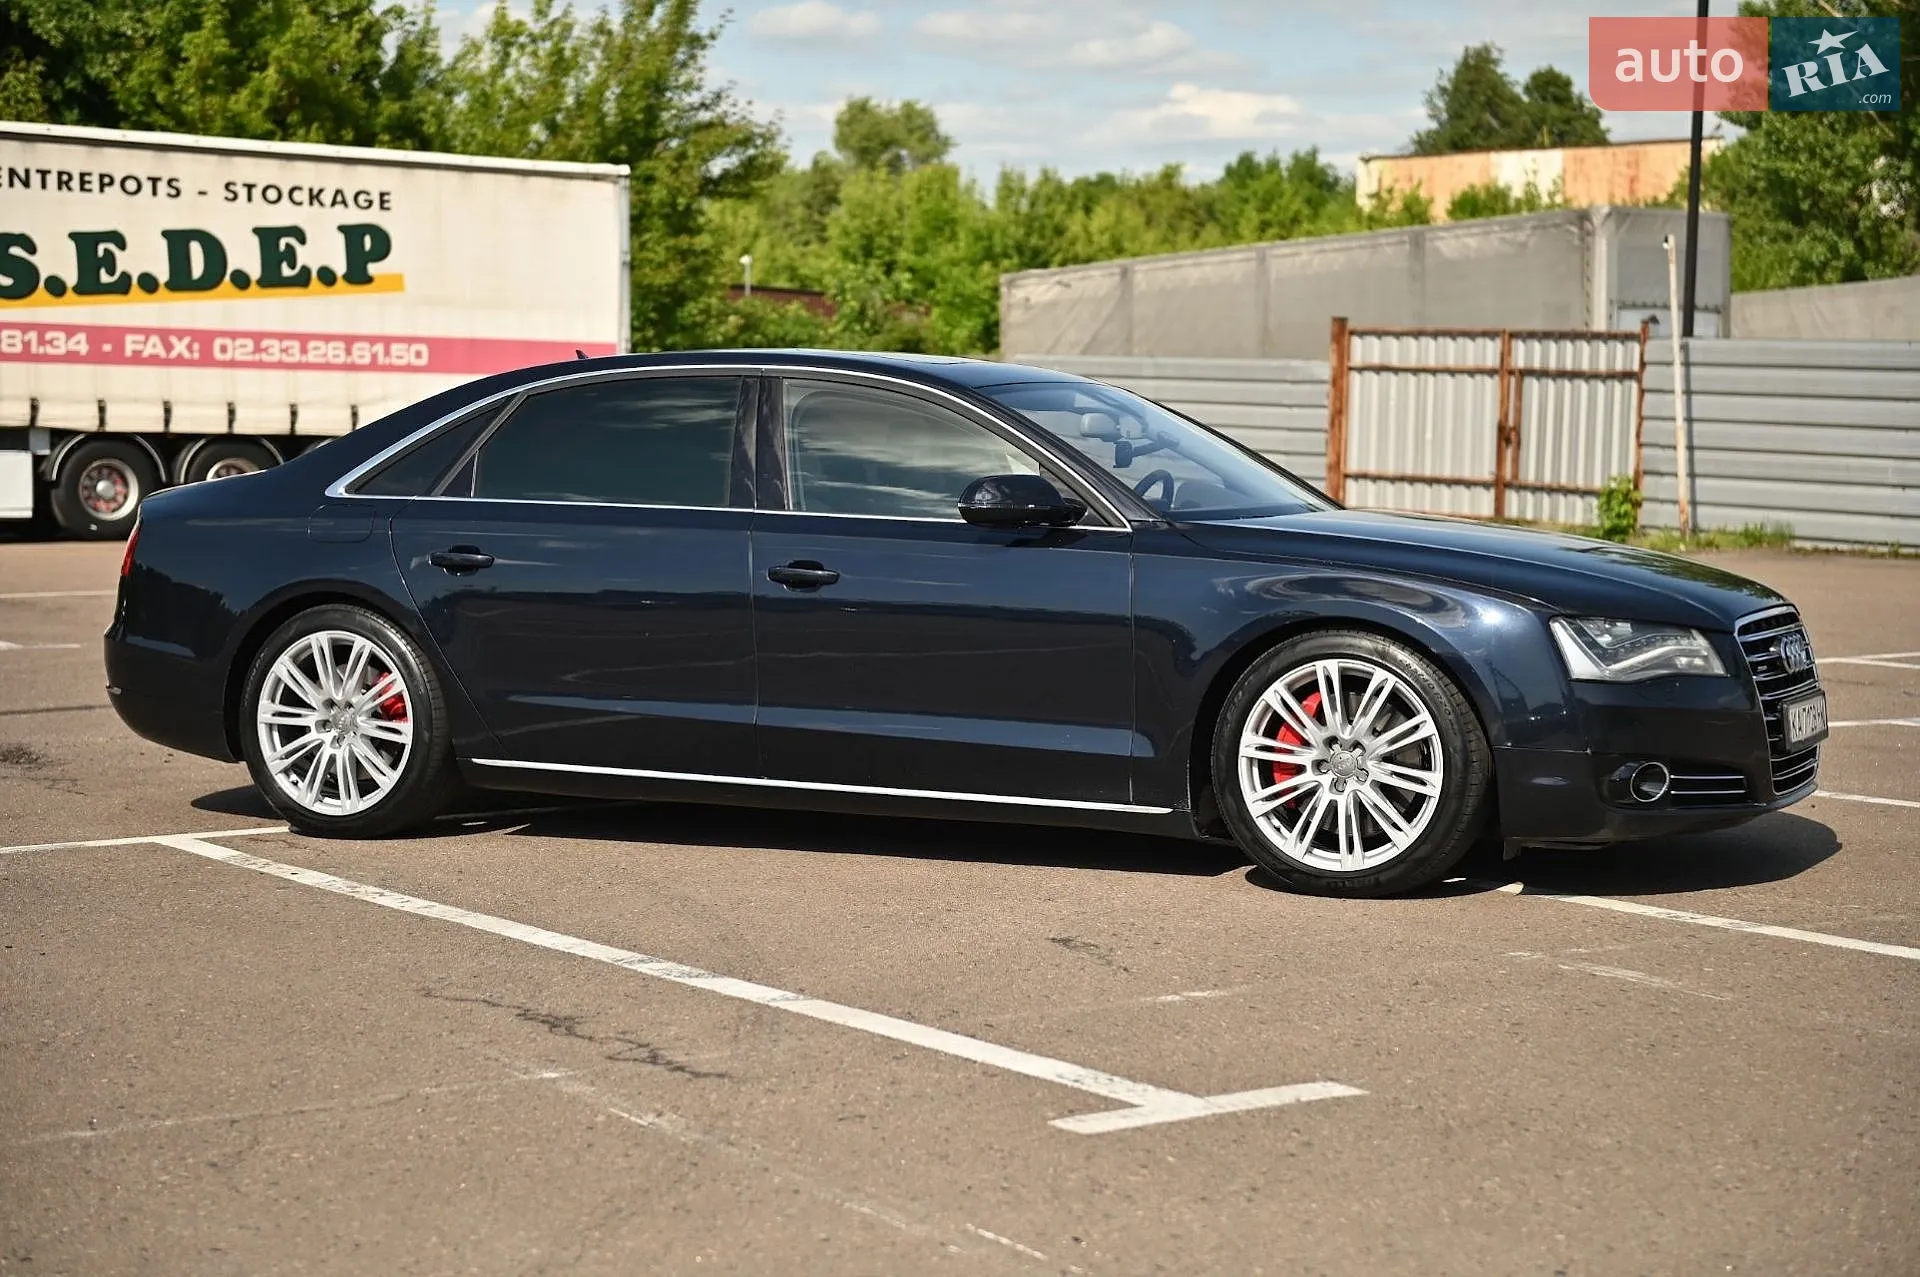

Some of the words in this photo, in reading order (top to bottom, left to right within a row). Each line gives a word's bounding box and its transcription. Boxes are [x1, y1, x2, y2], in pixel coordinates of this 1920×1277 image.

[0, 166, 182, 199] NTREPOTS
[223, 181, 392, 211] STOCKAGE
[0, 223, 392, 300] S.E.D.E.P
[124, 333, 200, 360] FAX:
